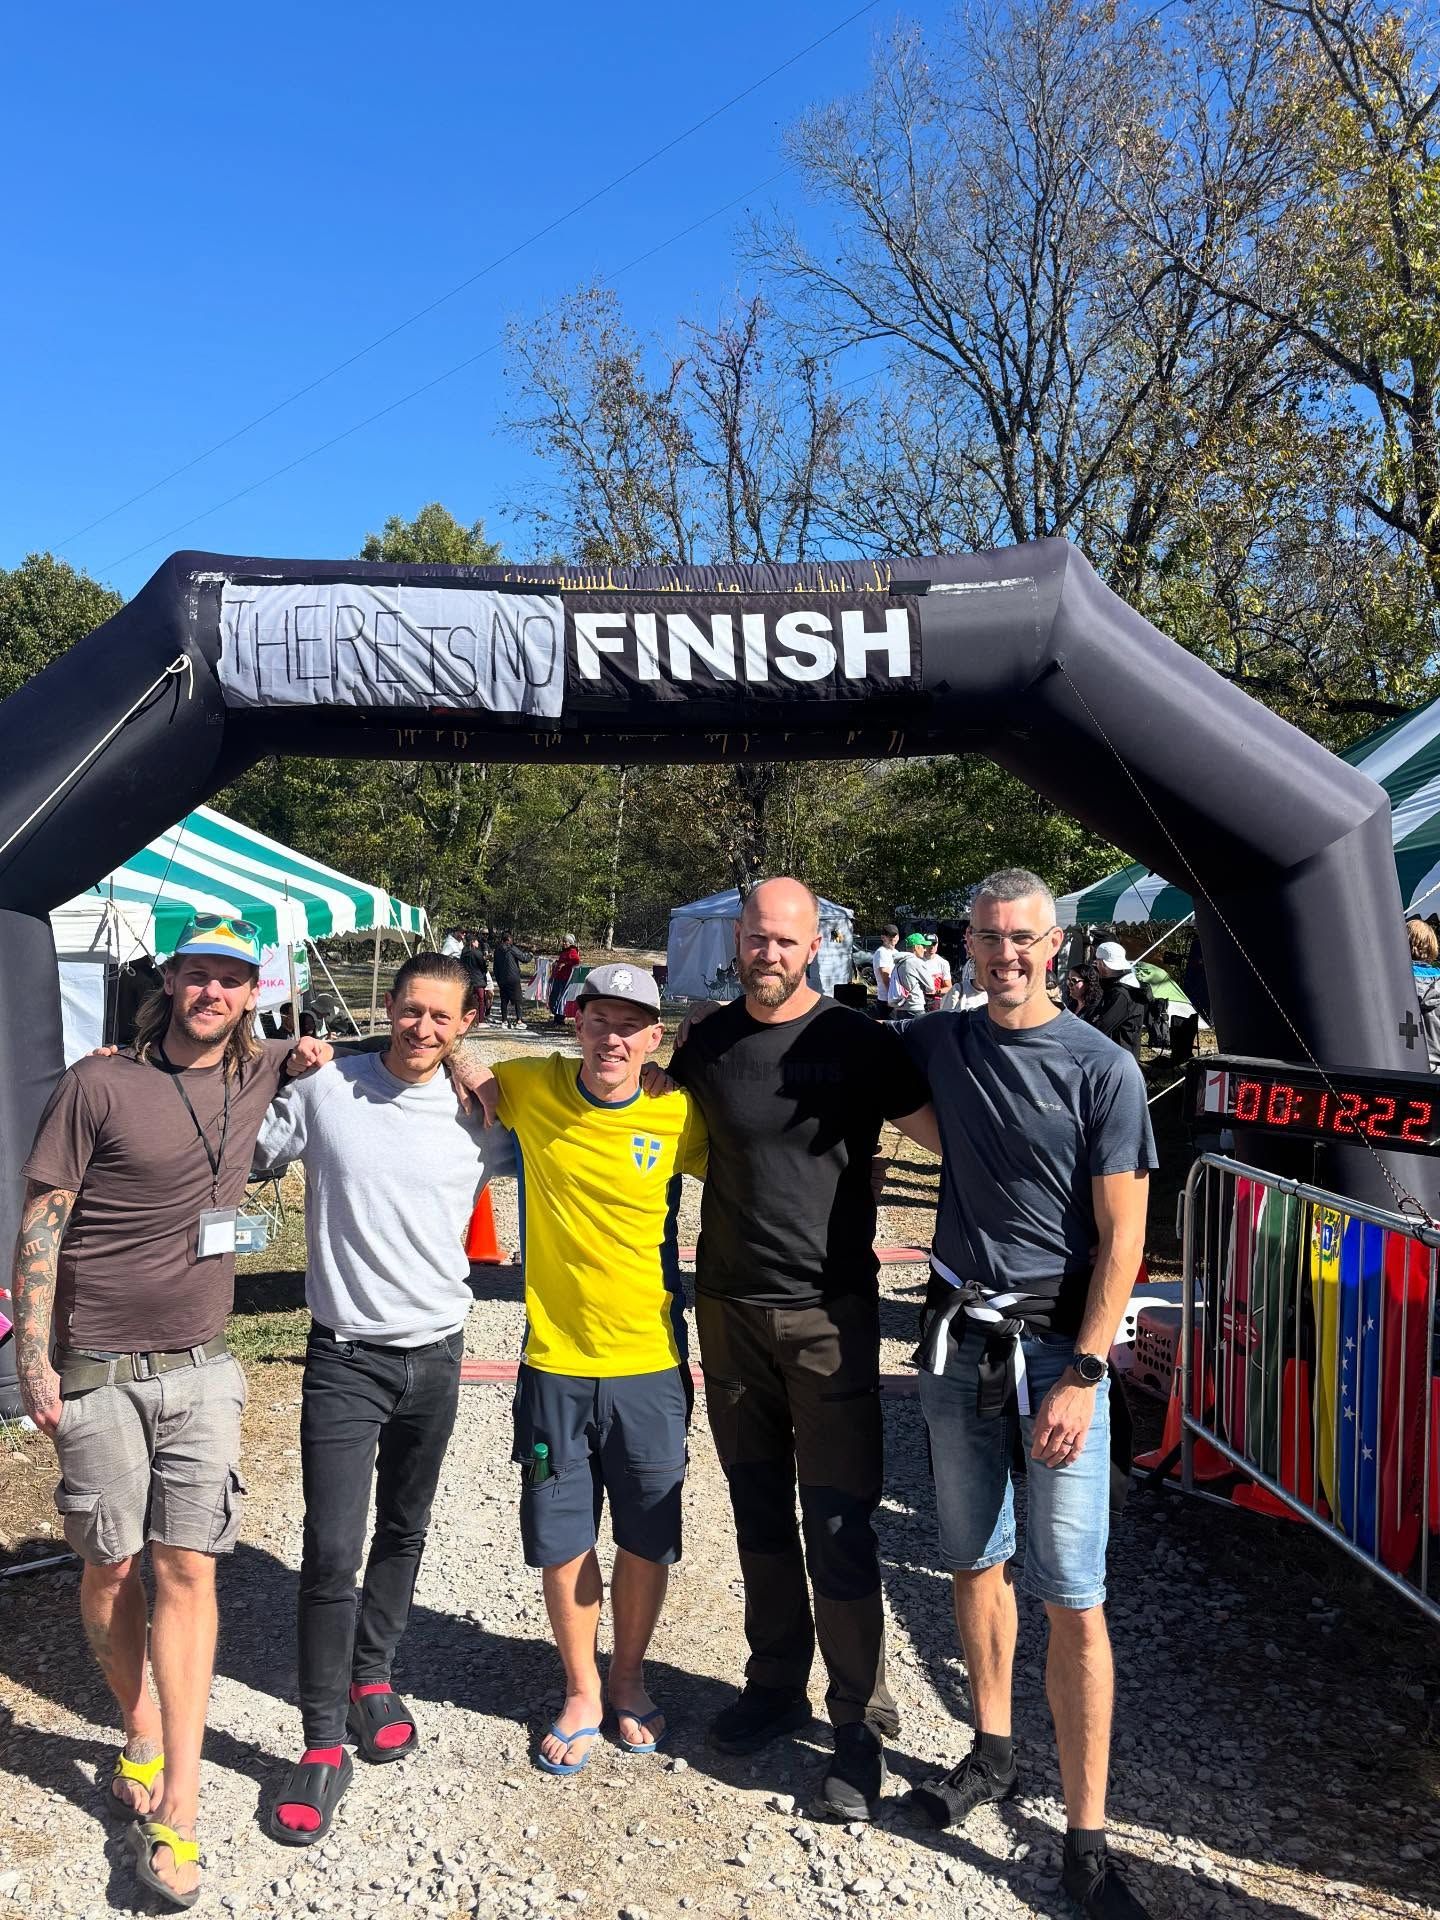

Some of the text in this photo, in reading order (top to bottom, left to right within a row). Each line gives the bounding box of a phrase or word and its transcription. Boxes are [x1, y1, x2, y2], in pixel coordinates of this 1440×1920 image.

[225, 600, 556, 697] THERE IS NO
[574, 608, 911, 681] FINISH
[1208, 1072, 1227, 1113] 1
[1235, 1082, 1432, 1142] 00:12:22
